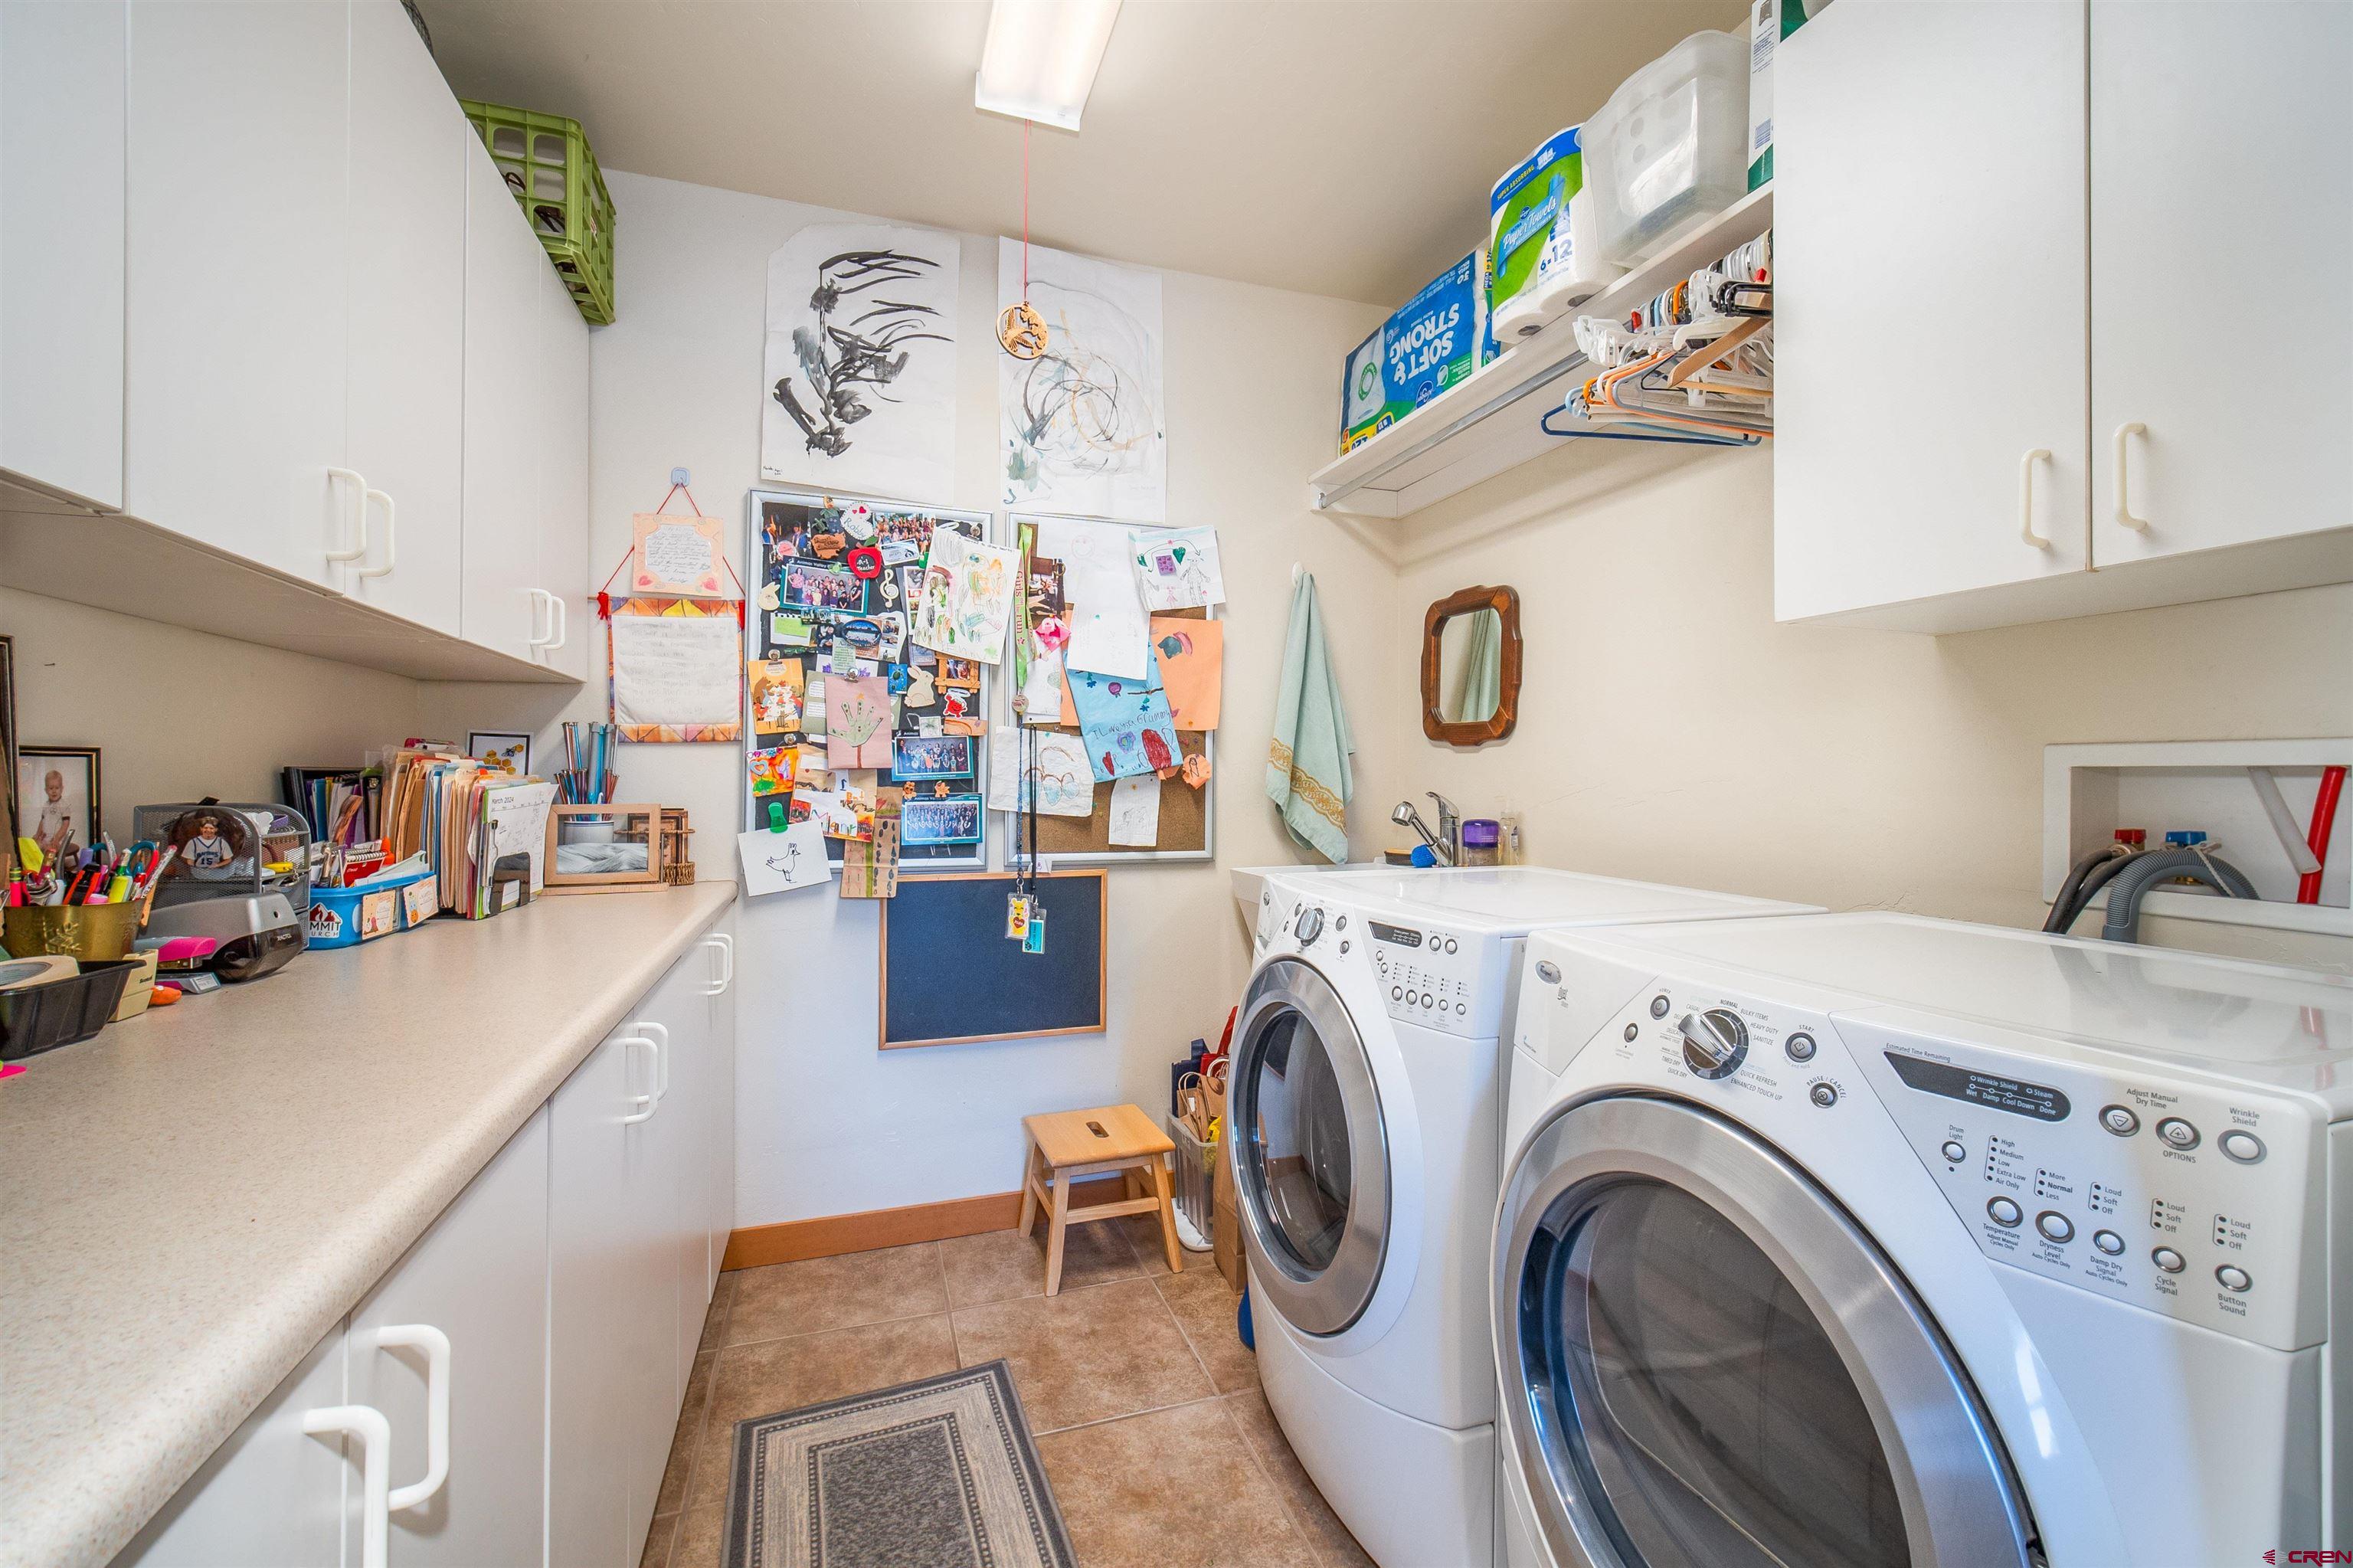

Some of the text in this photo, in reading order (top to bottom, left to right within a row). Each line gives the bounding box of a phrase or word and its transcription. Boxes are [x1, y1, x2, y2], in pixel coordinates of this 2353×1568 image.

[1497, 164, 1535, 201] SUPER ABSORBING
[1503, 218, 1528, 250] Paper
[1527, 194, 1556, 231] Towels
[1540, 258, 1546, 271] 6
[1552, 238, 1572, 265] 12
[1457, 270, 1469, 284] 30
[1389, 303, 1460, 365] STRONG
[1408, 330, 1455, 378] SOFT
[1393, 362, 1406, 386] &
[309, 921, 341, 931] MMIT
[1686, 1003, 1700, 1012] CASUAL
[1720, 999, 1739, 1009] NORMAL
[1740, 1008, 1769, 1021] BULKY ITEMS
[1750, 1022, 1779, 1035] HEAVY DUTY
[1799, 1024, 1815, 1033] START
[1753, 1034, 1774, 1046] SANITIZE
[1886, 1043, 1911, 1053] Estimated
[1924, 1050, 1952, 1063] Remaining
[1740, 1069, 1778, 1086] QUICK REFRESH
[1977, 1076, 2018, 1091] Wrinkle Shield
[1730, 1078, 1782, 1102] ENHANCED TOUCH UP
[1806, 1075, 1824, 1087] PAUSE
[1829, 1078, 1847, 1098] CANCEL
[2034, 1088, 2054, 1099] Steam
[2126, 1088, 2178, 1103] Adjust Manual
[1966, 1088, 2057, 1116] Wet Damp Cool Down Done
[2135, 1097, 2168, 1109] Dry Time
[2229, 1107, 2260, 1119] Wrinkle
[2232, 1115, 2257, 1127] Shield
[1949, 1124, 1965, 1134] Drum
[1949, 1131, 1963, 1141] Light
[2001, 1138, 2015, 1148] High
[1999, 1148, 2024, 1160] Medium
[2162, 1150, 2197, 1164] OPTIONS
[1998, 1158, 2010, 1167] Low
[1996, 1167, 2027, 1182] Extra Low
[2049, 1171, 2066, 1181] More
[1995, 1177, 2020, 1190] Air Only
[2047, 1181, 2073, 1193] Normal
[2046, 1190, 2060, 1201] Less
[2104, 1187, 2122, 1196] Loud
[2103, 1196, 2118, 1206] Soft
[2102, 1206, 2114, 1216] Off
[2167, 1202, 2185, 1213] Loud
[2166, 1213, 2182, 1223] Soft
[2230, 1218, 2251, 1230] Loud
[1983, 1223, 2021, 1239] Temperature
[2165, 1224, 2178, 1233] Off
[1986, 1232, 2019, 1246] Adjust Manual
[2230, 1229, 2247, 1241] Soft
[1990, 1239, 2015, 1251] Cycles Only
[2039, 1239, 2065, 1253] Dryness
[2228, 1240, 2243, 1251] Off
[2031, 1252, 2070, 1269] Auto Cycles Only
[2044, 1249, 2061, 1260] Level
[2090, 1255, 2123, 1272] Damp Dry
[2096, 1265, 2116, 1277] Signal
[2085, 1269, 2128, 1288] Auto Cycles Only
[2156, 1275, 2176, 1288] Cycle
[2155, 1283, 2178, 1296] Signal
[2217, 1292, 2247, 1308] Button
[2218, 1301, 2247, 1317] Sound
